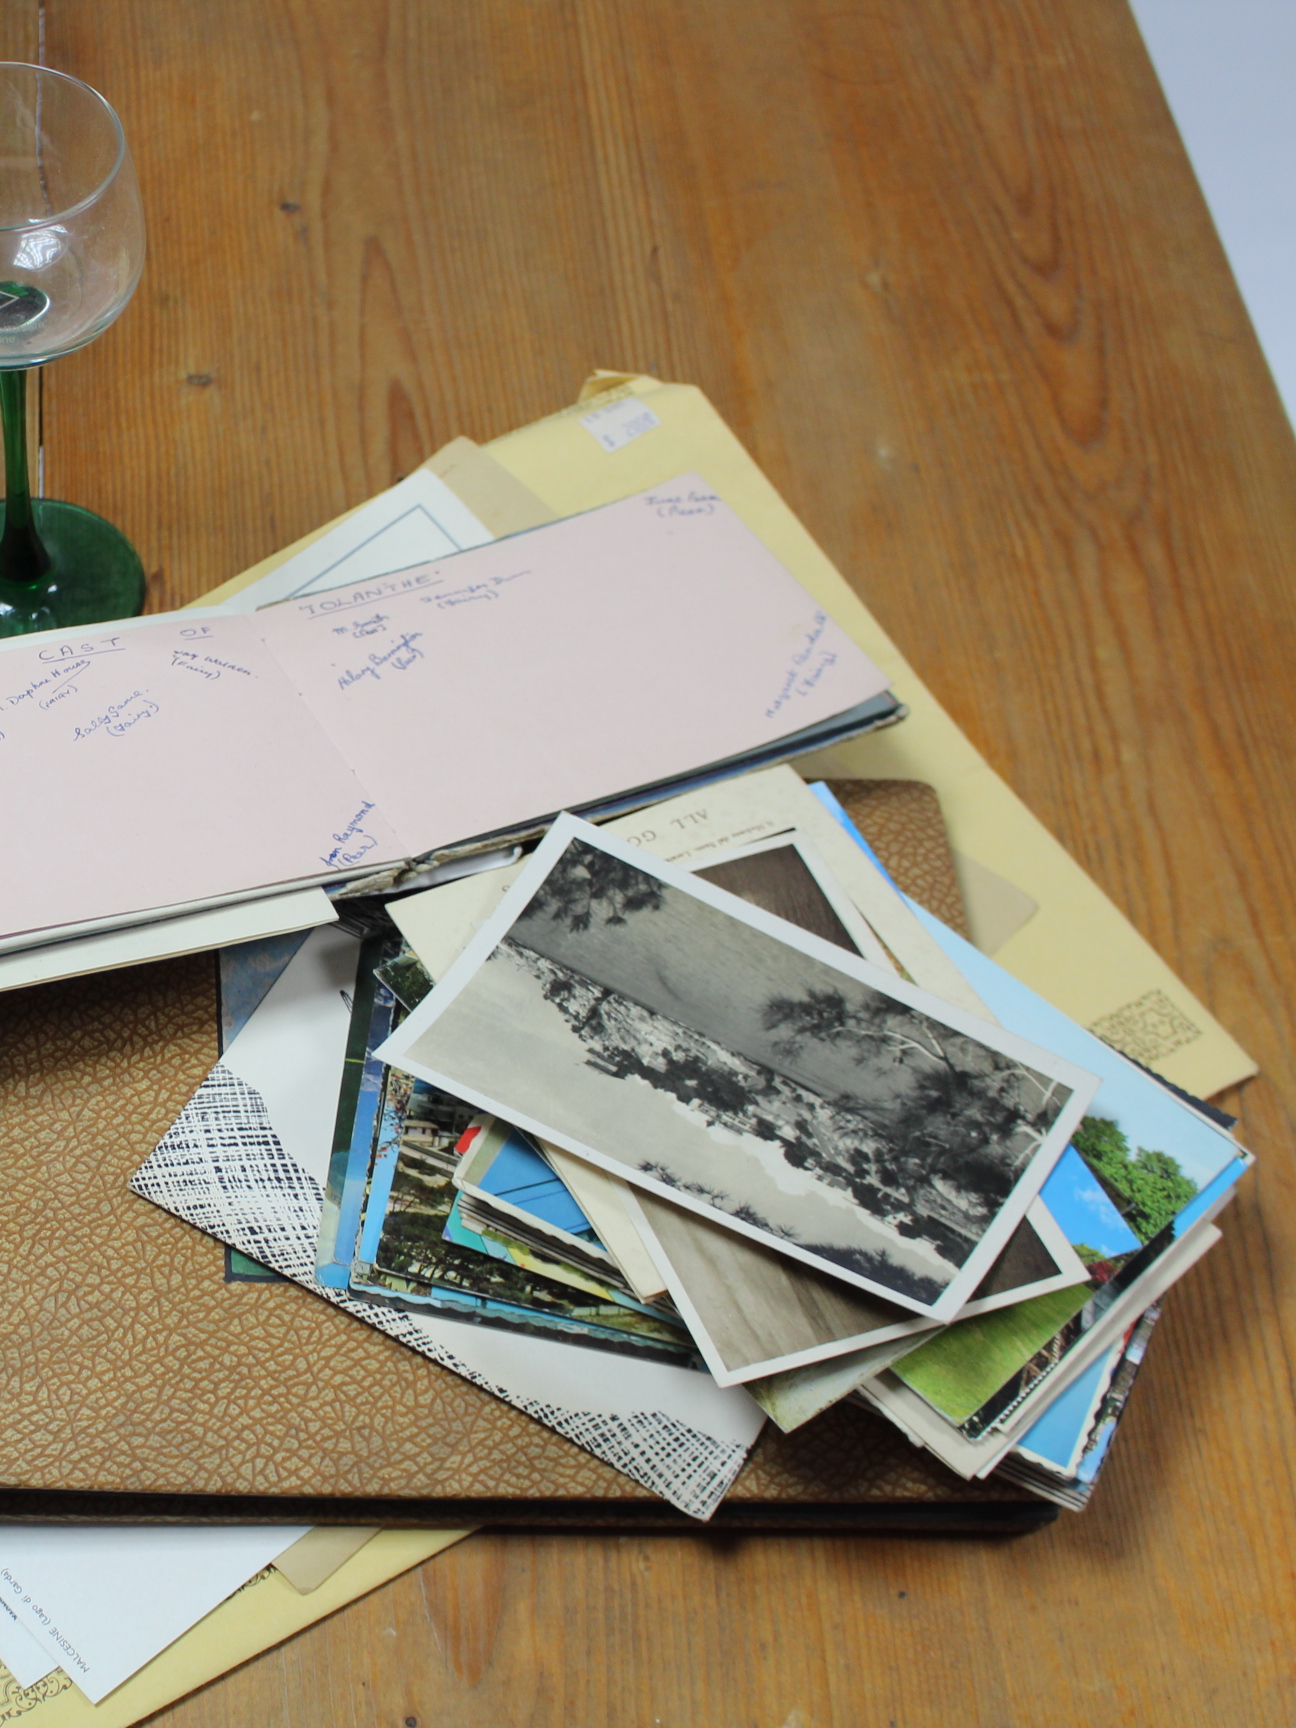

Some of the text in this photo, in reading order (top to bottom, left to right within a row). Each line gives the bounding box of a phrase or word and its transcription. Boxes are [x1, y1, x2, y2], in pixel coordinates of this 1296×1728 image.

[38, 636, 121, 661] CAST
[180, 626, 211, 637] OF
[332, 800, 375, 844] Raymond
[669, 808, 709, 830] ALL
[337, 834, 378, 867] (Peer)
[0, 1567, 23, 1594] Garda)
[21, 1595, 32, 1604] di
[31, 1604, 52, 1626] (Lago
[48, 1626, 91, 1673] MALCESINE
